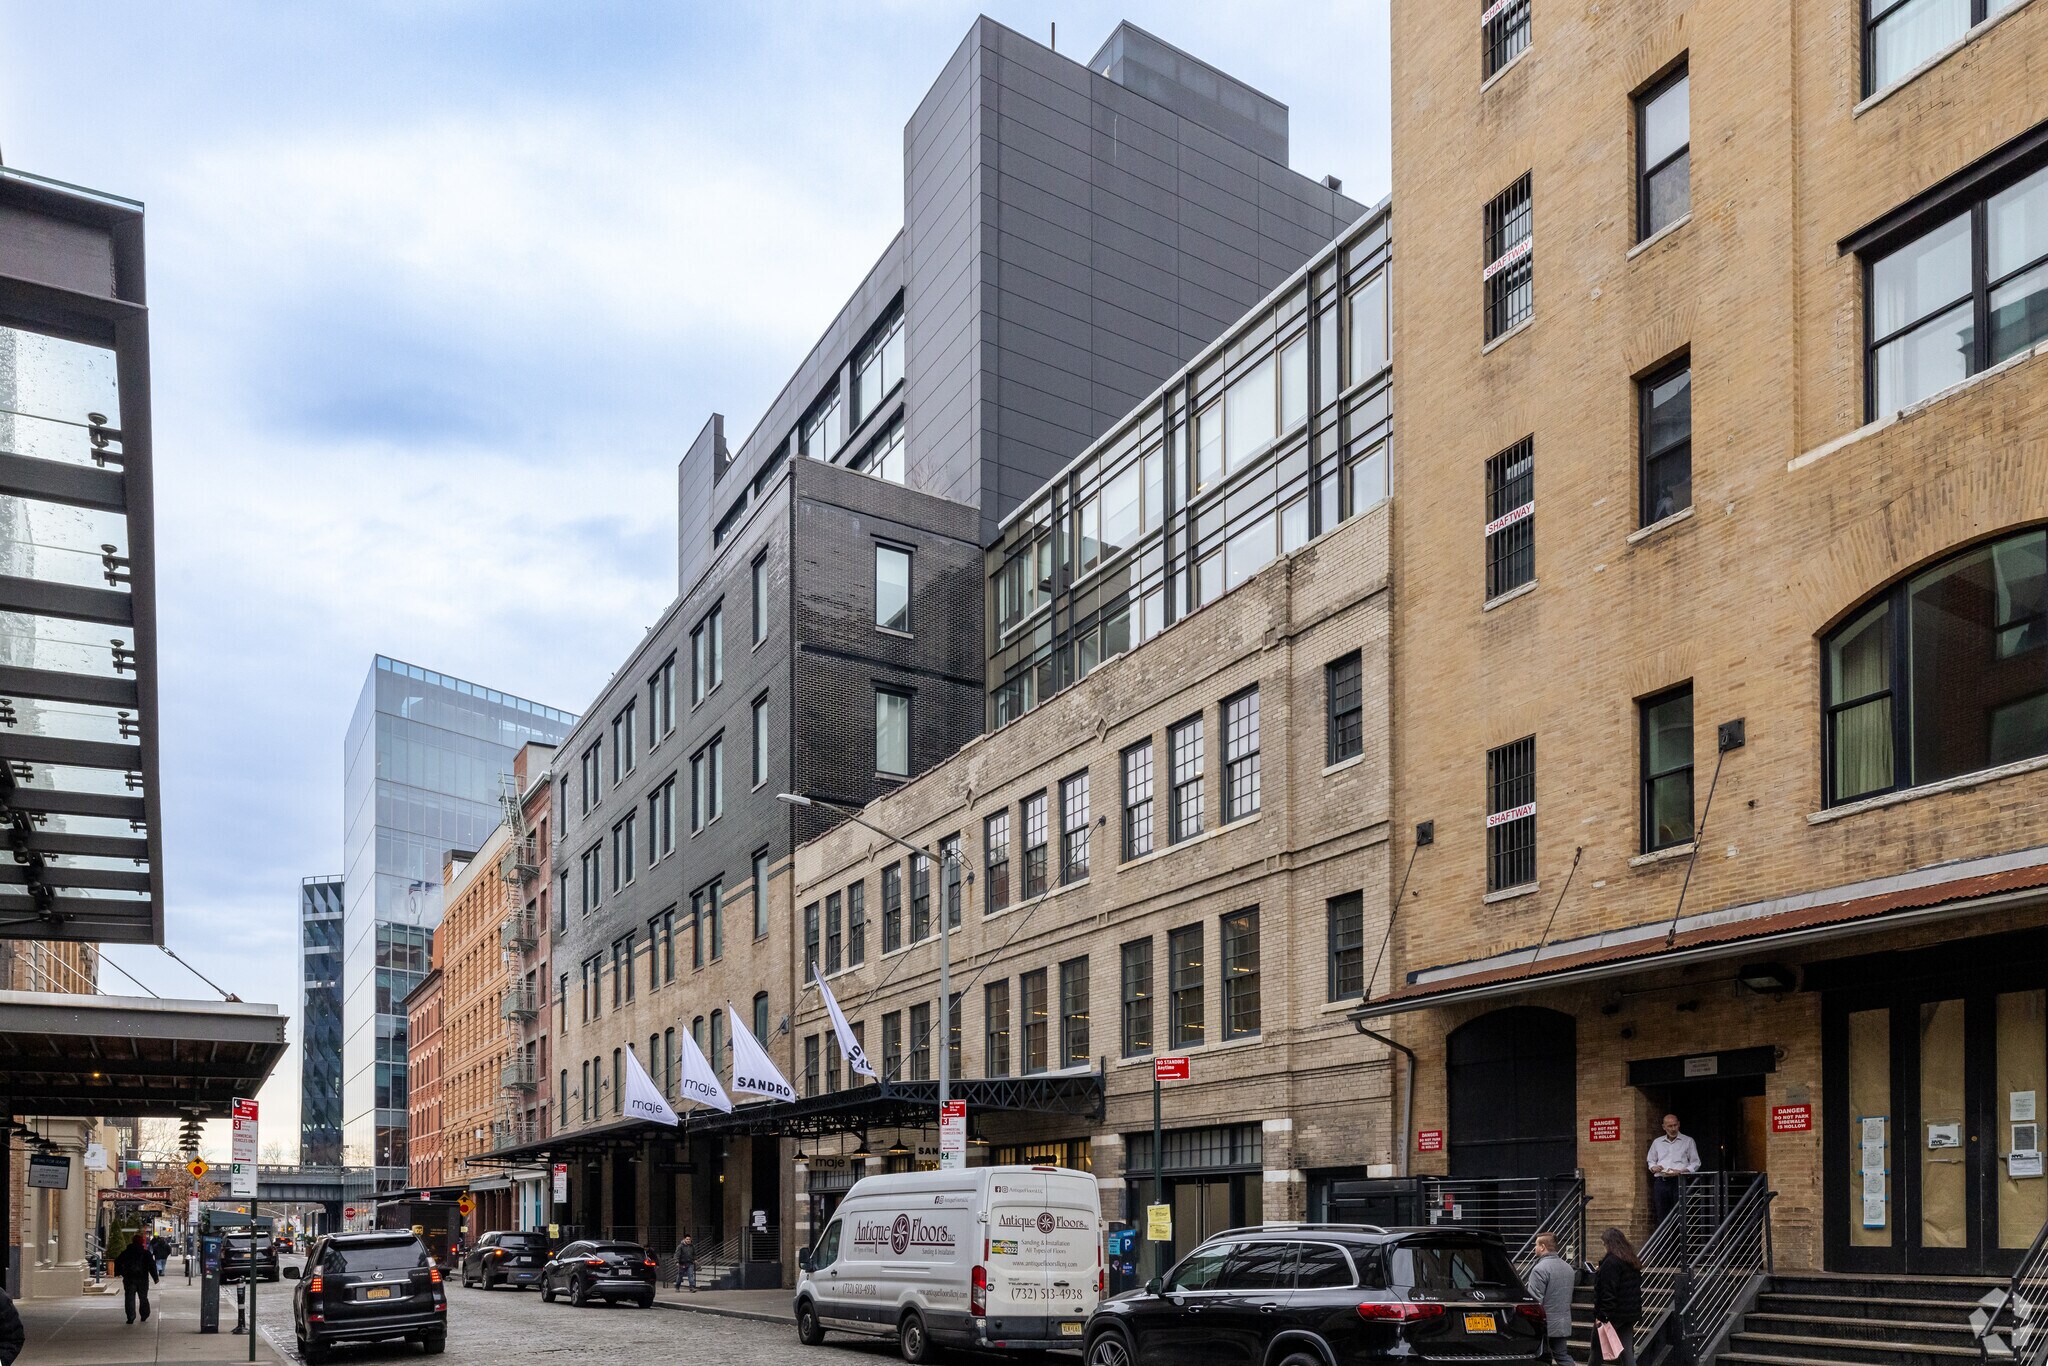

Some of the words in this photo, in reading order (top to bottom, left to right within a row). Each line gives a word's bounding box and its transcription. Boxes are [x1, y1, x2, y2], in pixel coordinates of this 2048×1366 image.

[1486, 241, 1529, 278] SHAFTWAY
[1488, 504, 1532, 534] SHAFTWAY
[1490, 804, 1533, 826] SHAFTWAY
[685, 1078, 718, 1096] maje
[738, 1076, 790, 1096] SANDRO
[632, 1100, 663, 1114] maje
[235, 1121, 239, 1129] 3
[234, 1165, 238, 1173] 2
[816, 1158, 845, 1168] maje
[999, 1214, 1036, 1232] Antique
[1056, 1216, 1084, 1228] Floors
[854, 1220, 890, 1254] Antique
[911, 1216, 948, 1241] Floors
[210, 1244, 216, 1252] P
[1125, 1240, 1130, 1250] P
[842, 1283, 854, 1295] (732)
[855, 1284, 876, 1295] 513-4938
[1011, 1288, 1036, 1300] (732)
[1041, 1288, 1083, 1300] 513-4938
